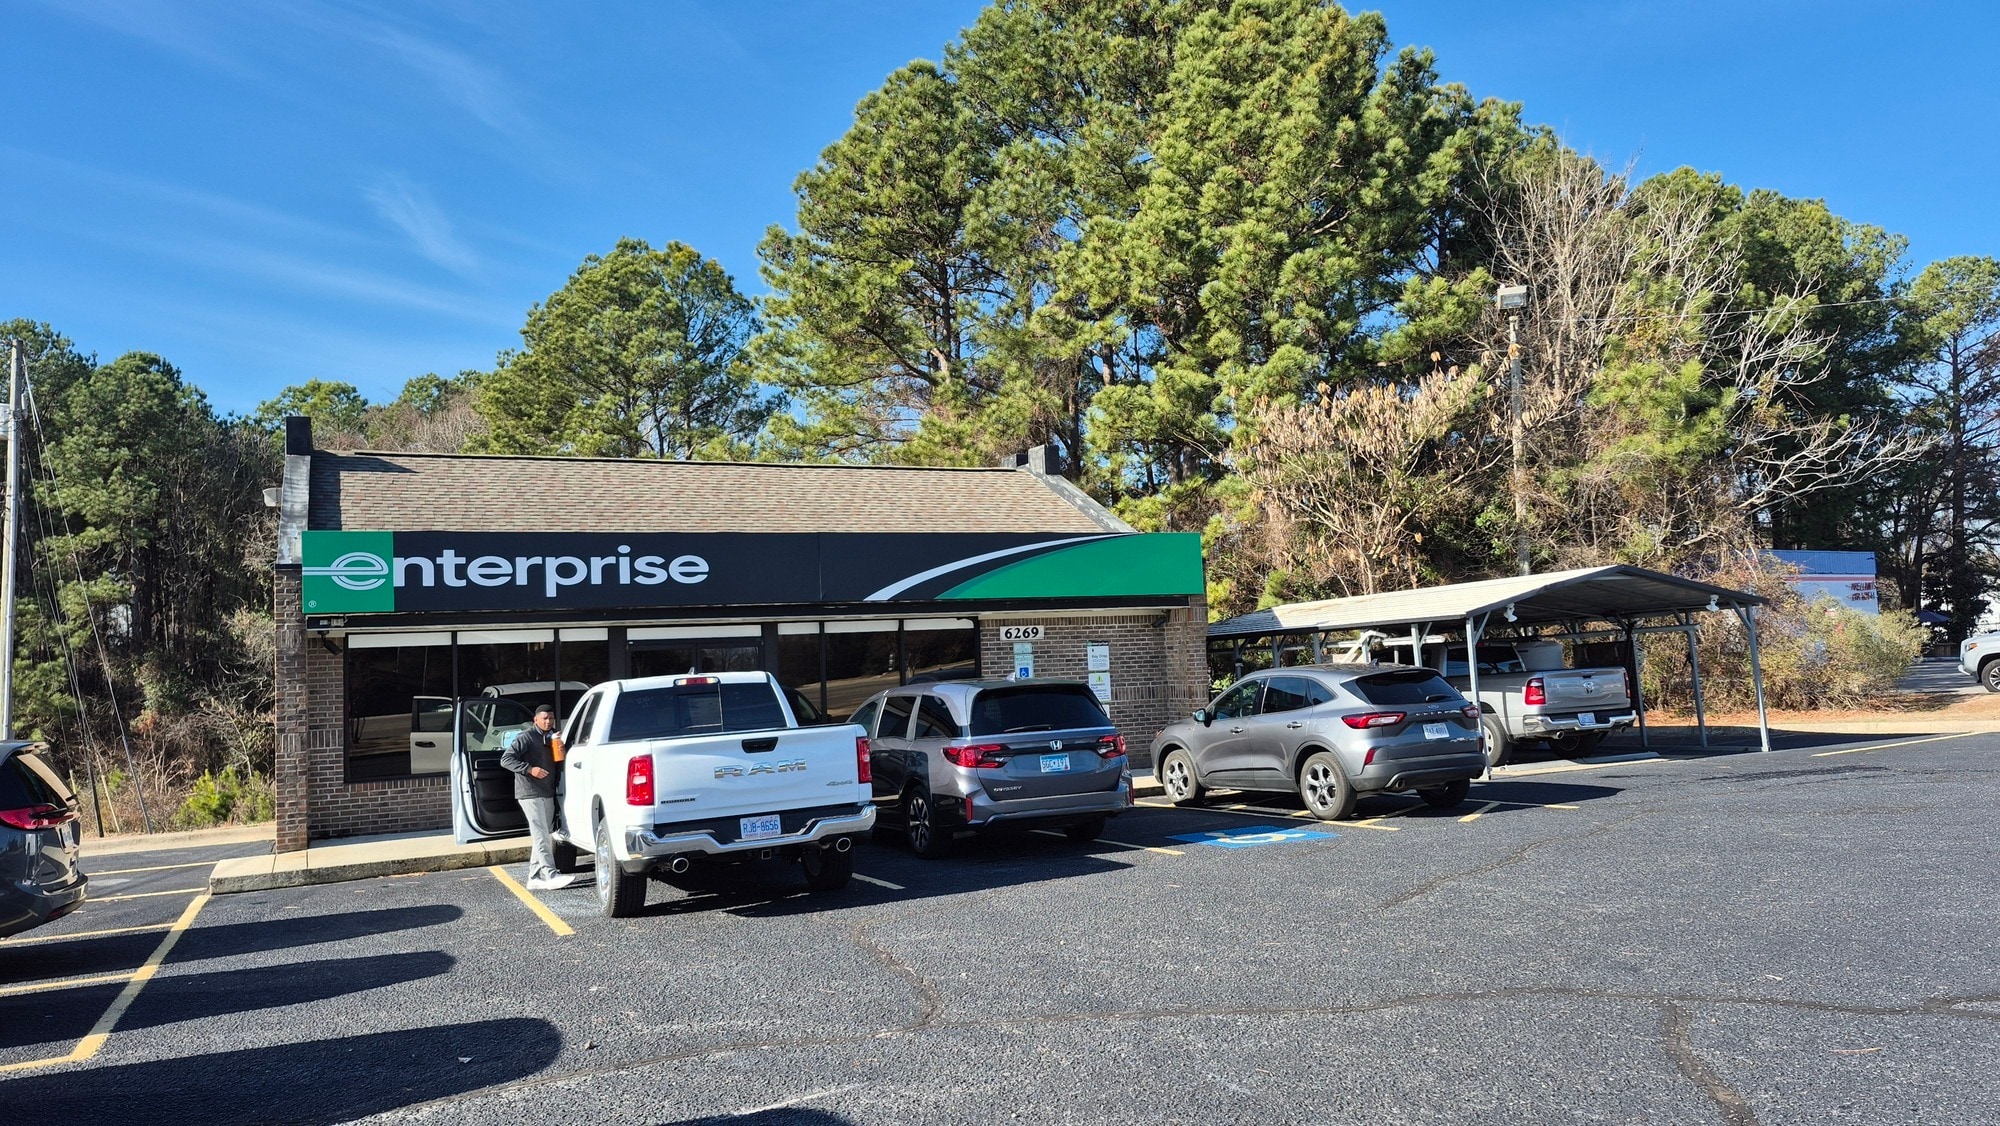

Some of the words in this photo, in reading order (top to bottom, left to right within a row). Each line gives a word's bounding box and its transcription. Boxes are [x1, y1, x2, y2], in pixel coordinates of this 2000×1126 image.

[302, 544, 710, 598] enterprise
[1004, 627, 1039, 639] 6269
[714, 758, 807, 779] RAM
[742, 820, 779, 833] RJB-8656
